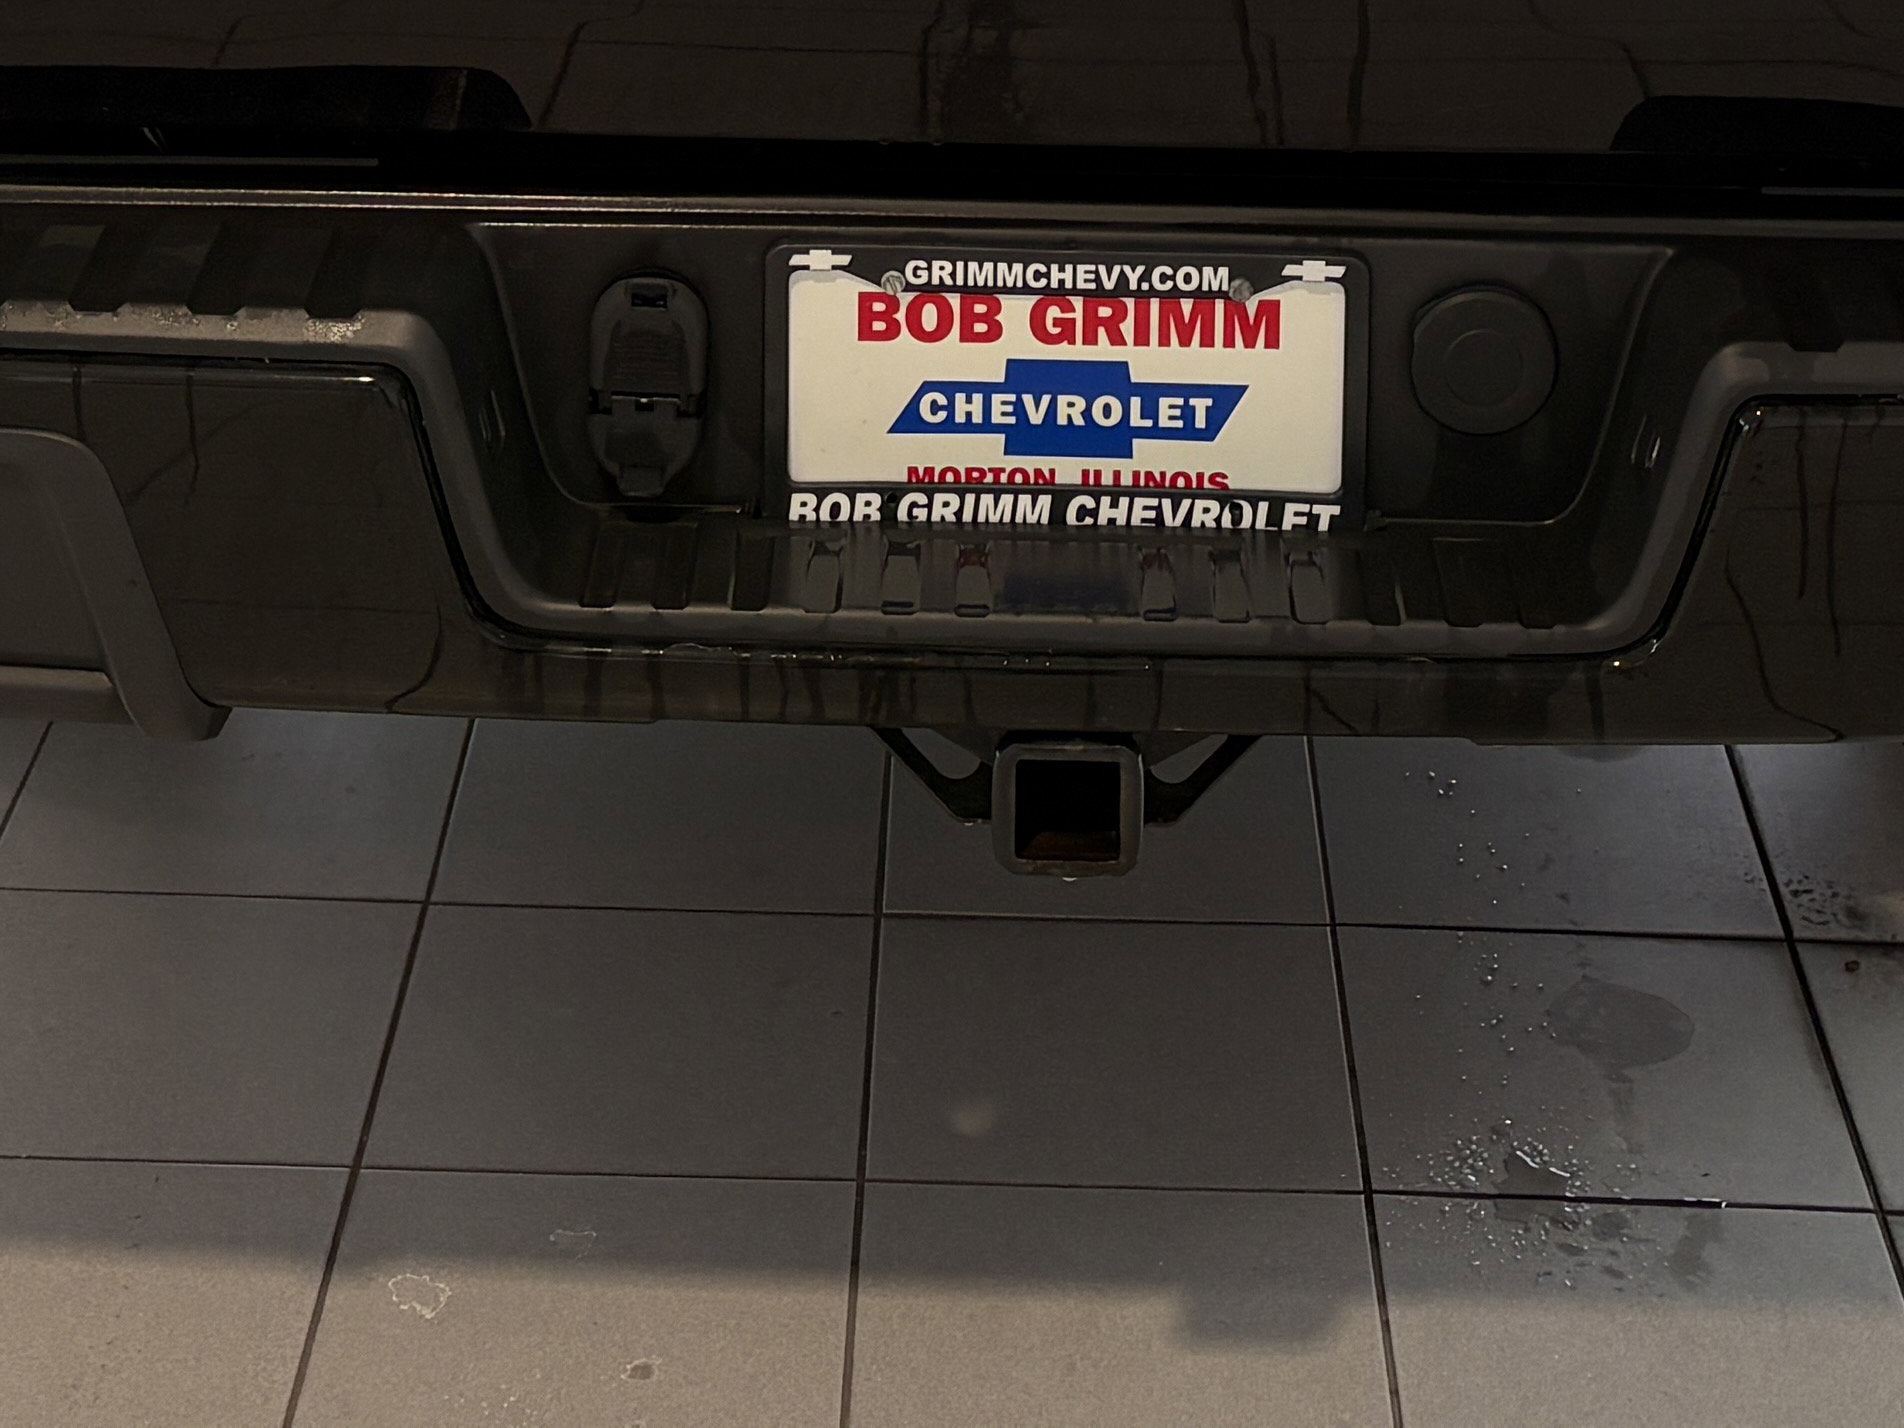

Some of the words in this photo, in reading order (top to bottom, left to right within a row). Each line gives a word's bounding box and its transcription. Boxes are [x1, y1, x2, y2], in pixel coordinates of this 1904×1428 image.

[903, 259, 1230, 292] GRIMMCHEVY.COM
[856, 291, 1004, 343] BOB
[1028, 295, 1282, 350] GRIMM
[918, 391, 1214, 429] CHEVROLET
[906, 465, 1057, 486] MORTON
[788, 491, 882, 523] BOB
[896, 491, 1053, 525] GRIMM
[1065, 494, 1342, 533] CHEVROLET
